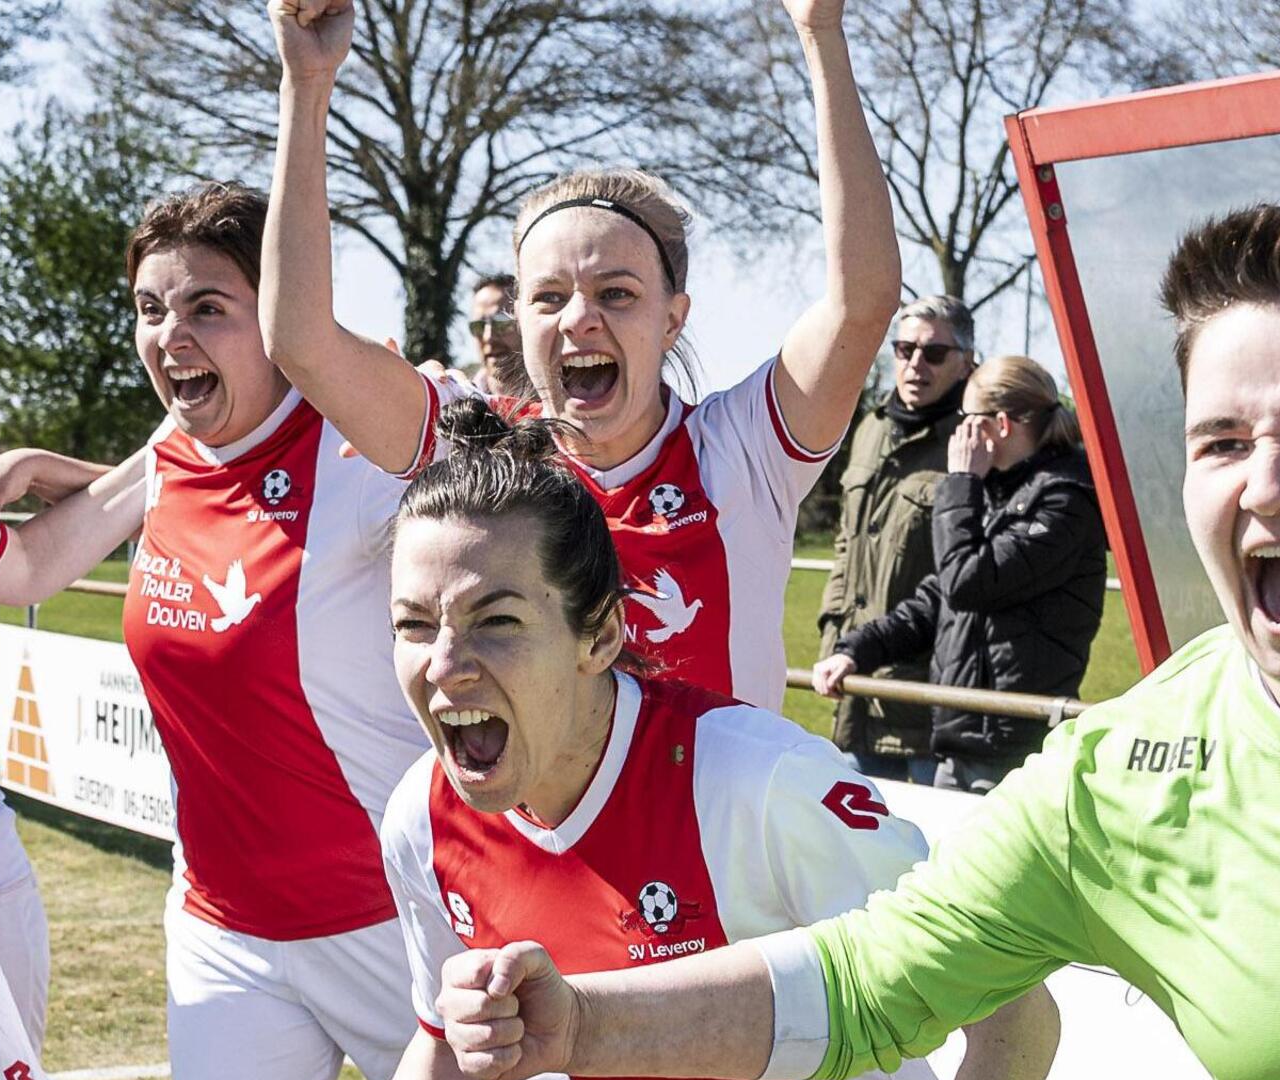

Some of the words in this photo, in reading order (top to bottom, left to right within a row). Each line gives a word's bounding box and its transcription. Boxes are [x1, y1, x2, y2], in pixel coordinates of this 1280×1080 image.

[259, 509, 299, 521] Leveroy
[660, 510, 707, 533] everoy
[169, 557, 183, 579] &
[140, 573, 195, 604] TRAILER
[146, 601, 208, 633] DOUVEN
[628, 944, 645, 960] SV
[648, 937, 706, 957] Leveroy
